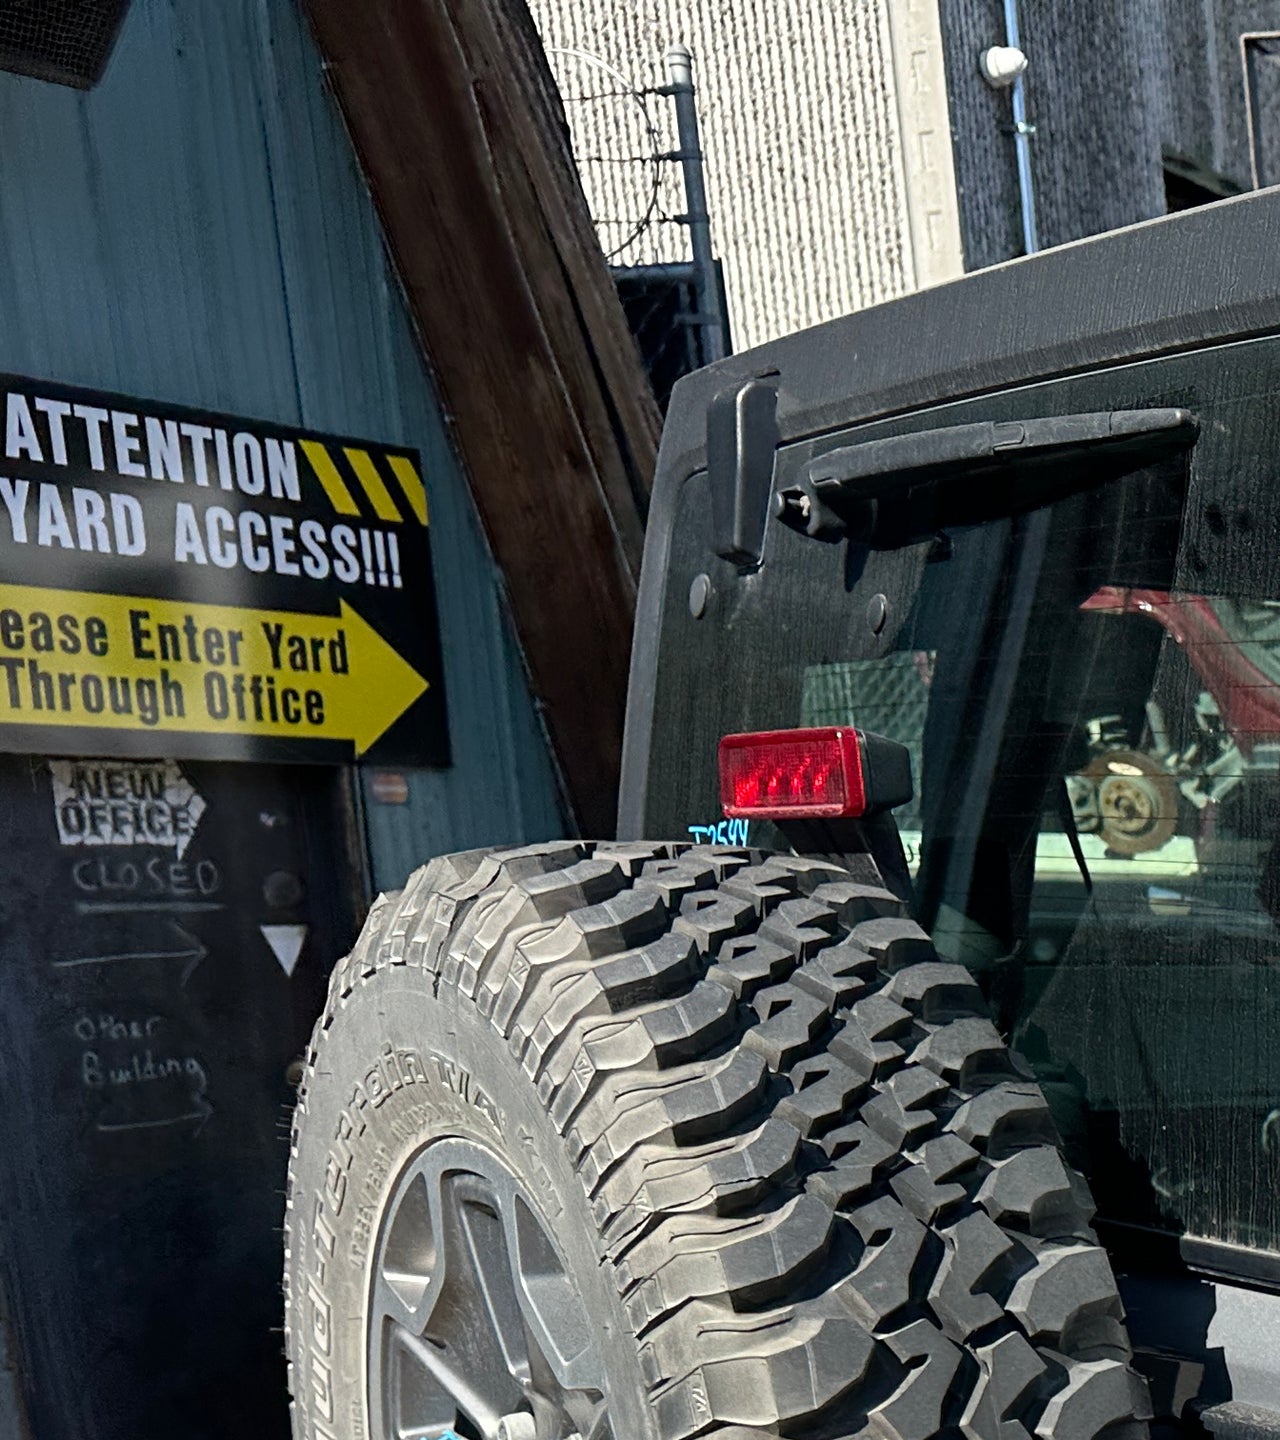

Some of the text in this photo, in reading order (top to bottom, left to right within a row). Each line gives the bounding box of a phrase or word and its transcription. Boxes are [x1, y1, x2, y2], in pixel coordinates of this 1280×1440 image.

[5, 392, 301, 501] ATTENTION
[0, 477, 403, 589] YARD ACCESS!!!
[0, 607, 349, 676] ease Enter Yard
[0, 656, 326, 727] Through Office
[74, 765, 166, 800] NEW
[72, 858, 224, 896] CLOSED
